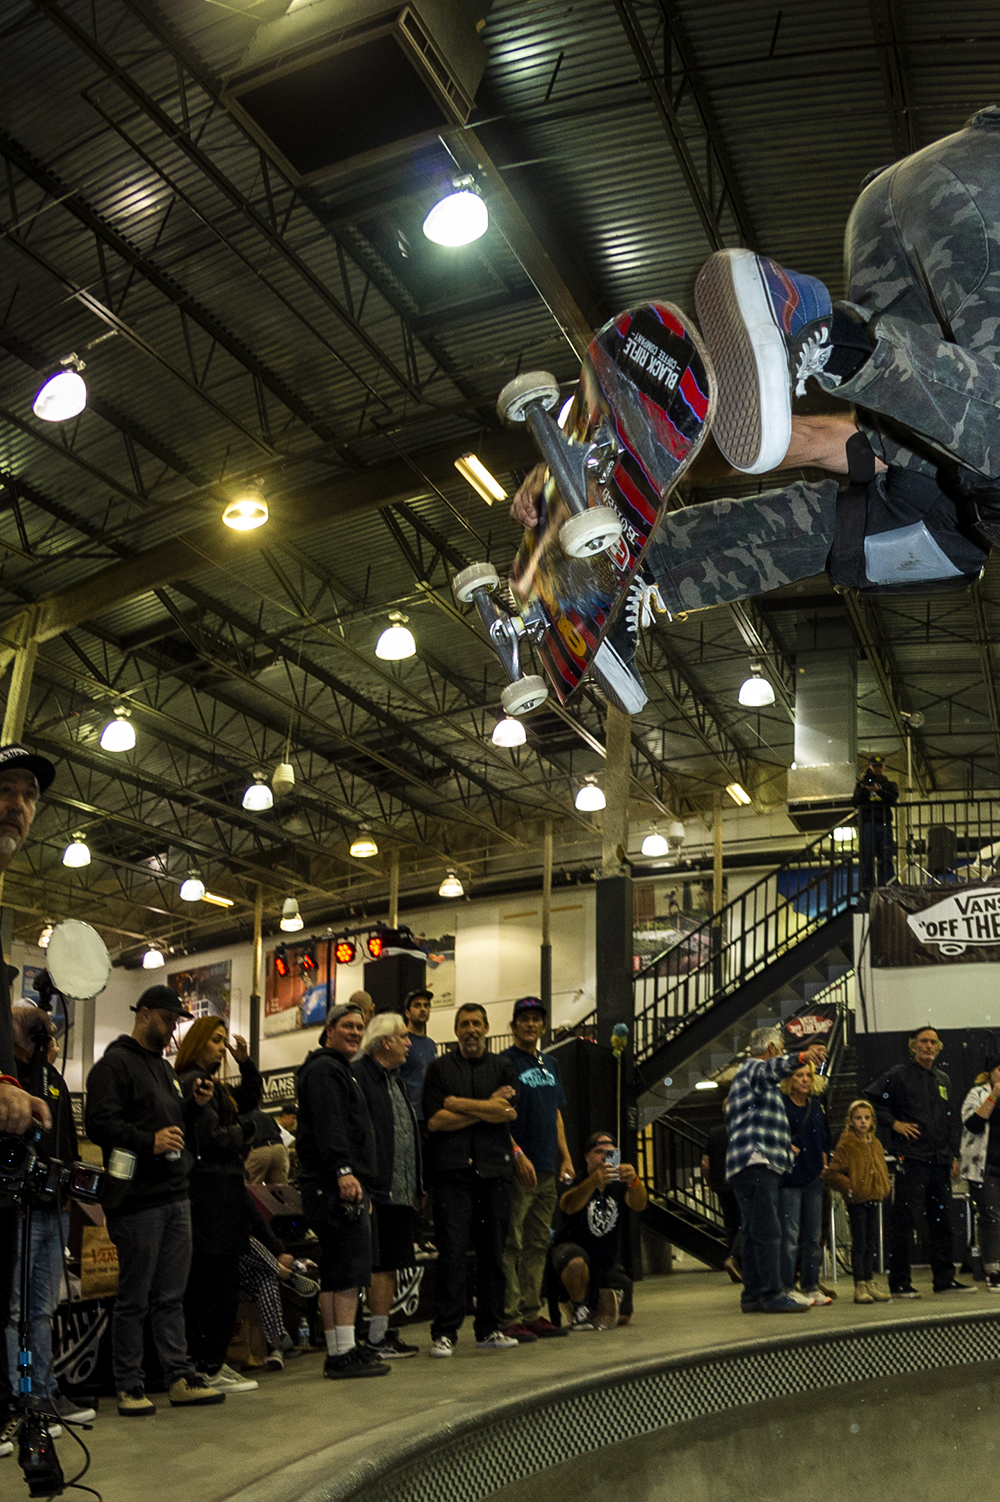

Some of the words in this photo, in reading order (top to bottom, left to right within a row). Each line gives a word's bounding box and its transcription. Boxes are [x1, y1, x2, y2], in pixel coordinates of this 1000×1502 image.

[623, 338, 650, 368] RIFLE
[634, 332, 658, 355] COMPANY
[646, 356, 679, 390] BLACK
[660, 350, 678, 370] COFFEE
